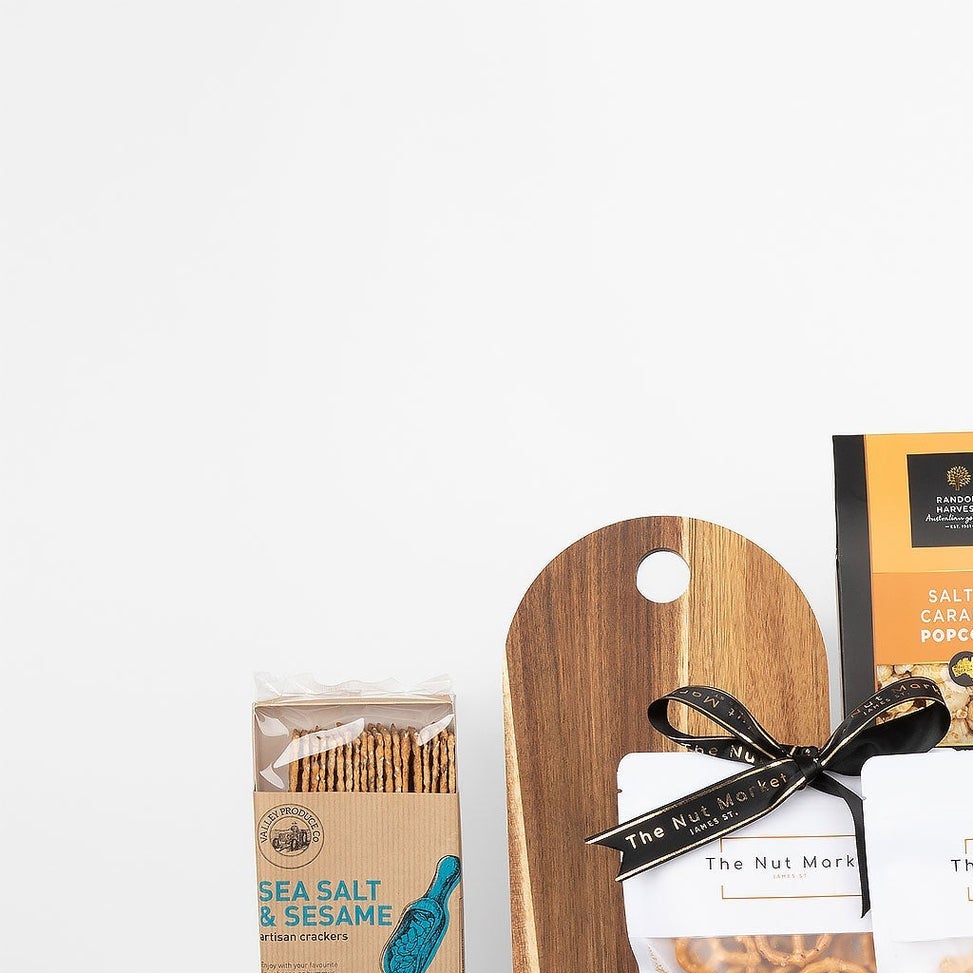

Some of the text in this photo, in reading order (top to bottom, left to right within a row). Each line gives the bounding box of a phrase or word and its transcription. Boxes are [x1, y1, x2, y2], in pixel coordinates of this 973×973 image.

[925, 513, 965, 522] Australian
[624, 772, 788, 851] The Nut Market
[260, 810, 280, 844] VALLEY
[279, 806, 319, 830] PRODUCE
[705, 854, 856, 871] The Nut Mark
[259, 879, 382, 903] SEA SALT
[260, 904, 393, 927] & SESAME
[260, 931, 349, 942] artisan crackers
[278, 961, 292, 969] with
[293, 962, 308, 971] your
[309, 961, 339, 969] favourite
